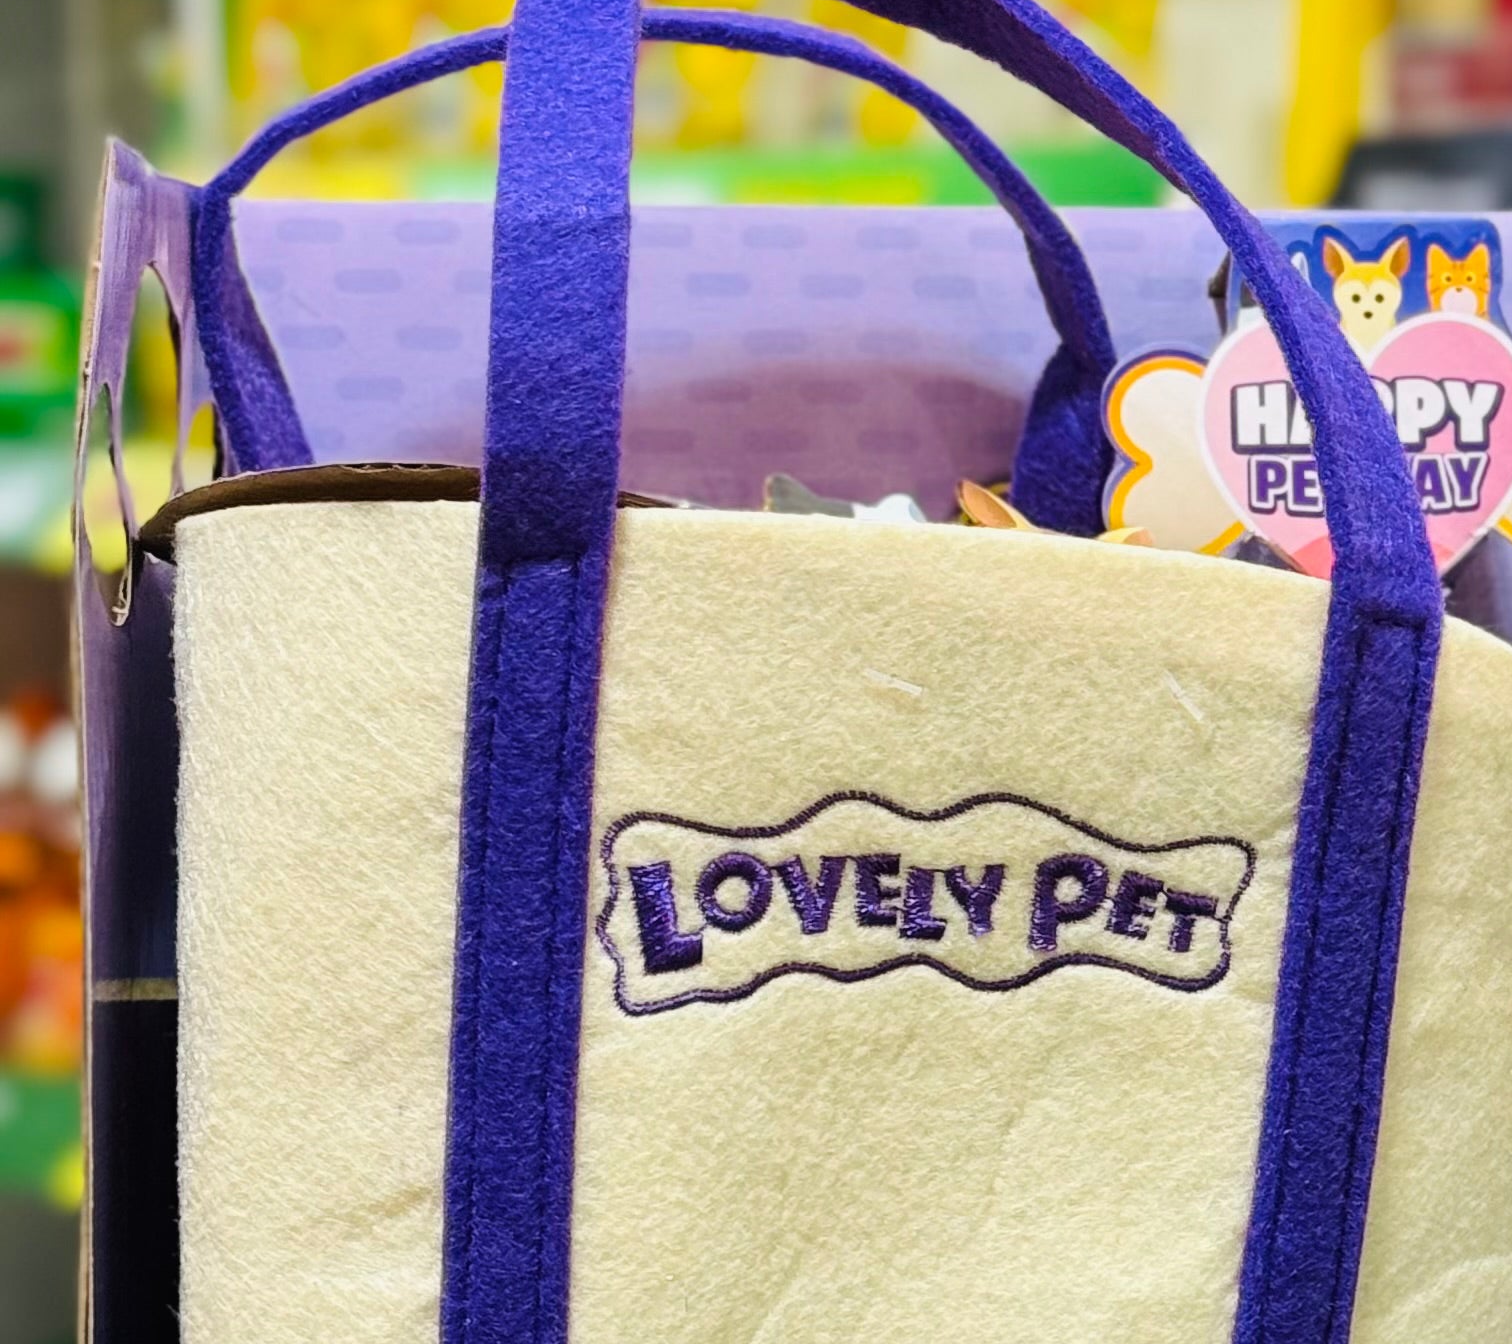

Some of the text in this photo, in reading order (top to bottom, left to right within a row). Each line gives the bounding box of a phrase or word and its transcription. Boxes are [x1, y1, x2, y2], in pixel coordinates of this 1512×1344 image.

[1248, 455, 1325, 516] PE
[627, 852, 1218, 975] LOVELY PET
